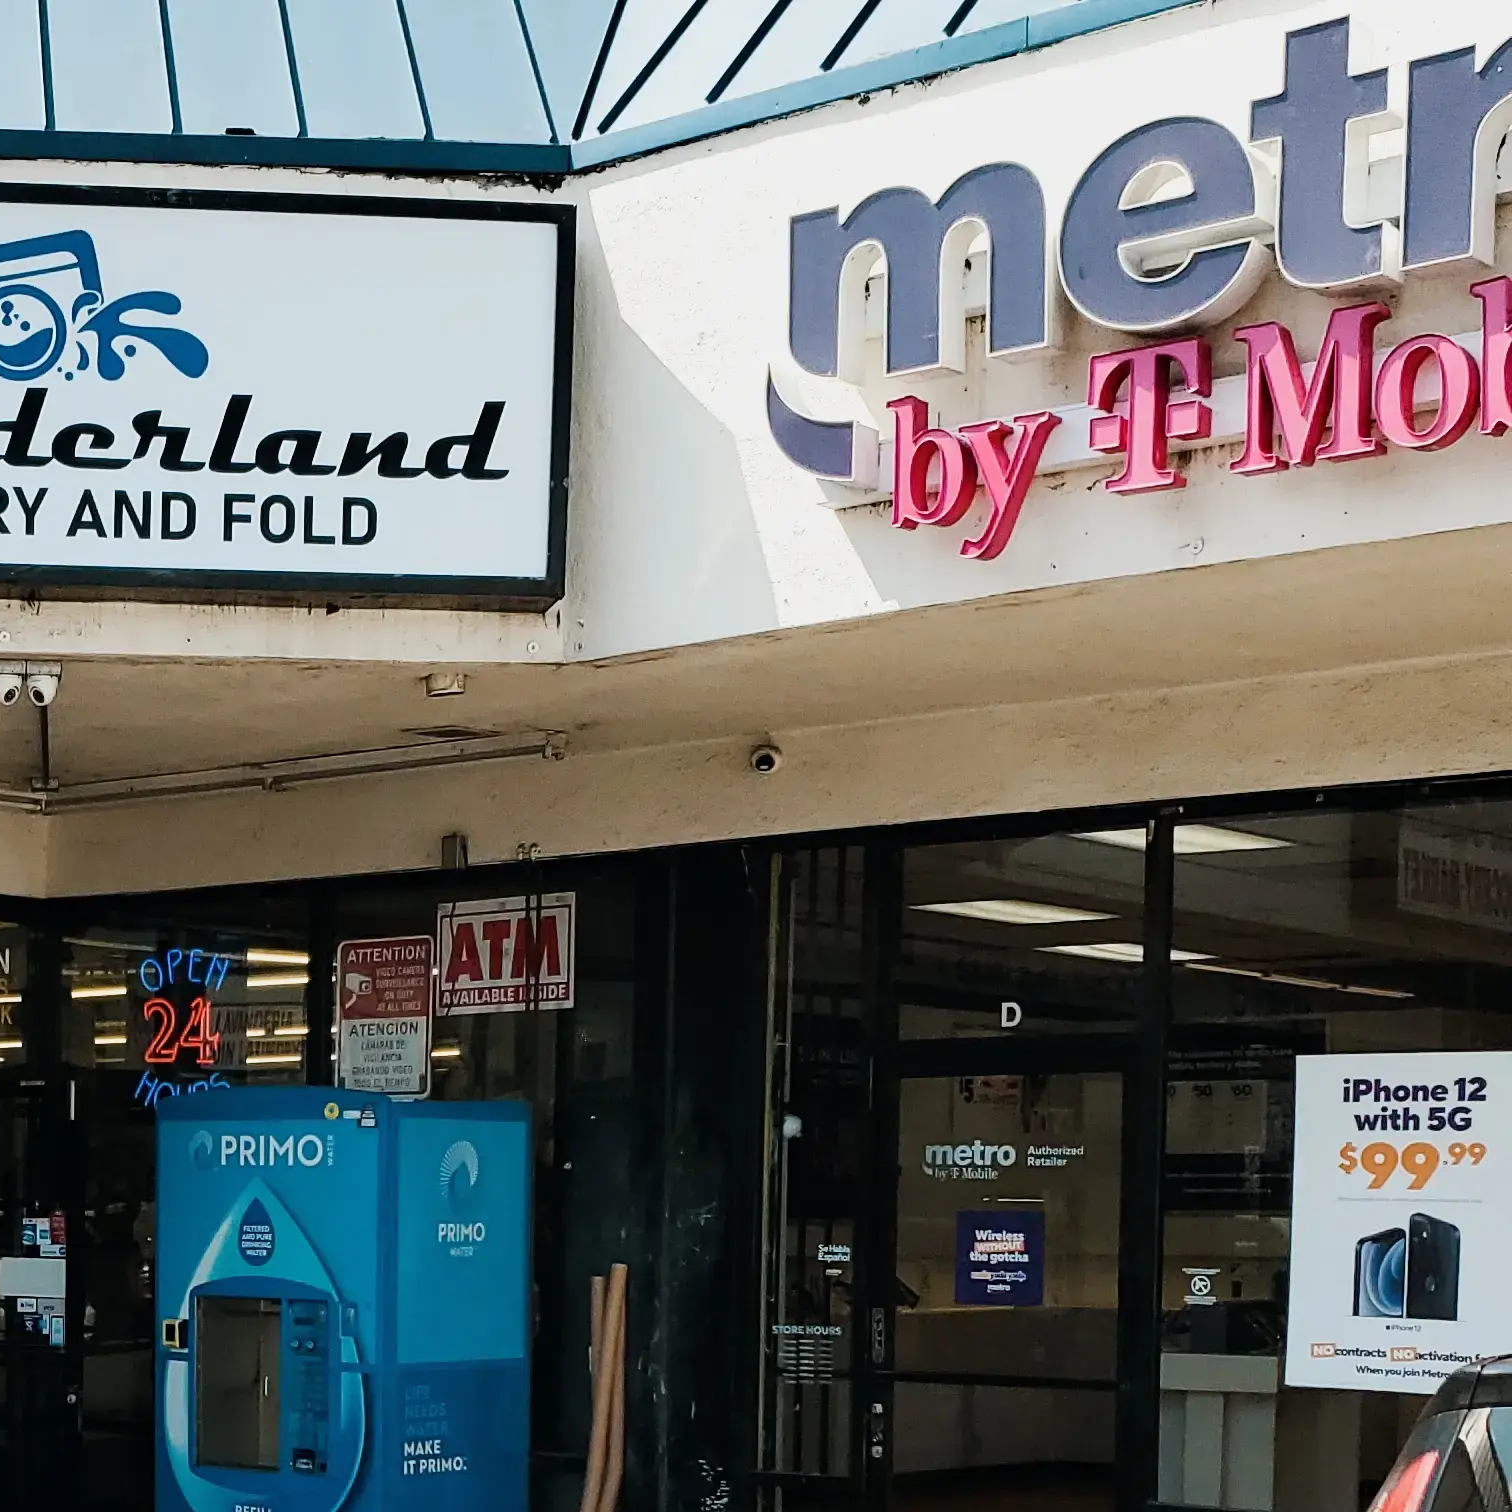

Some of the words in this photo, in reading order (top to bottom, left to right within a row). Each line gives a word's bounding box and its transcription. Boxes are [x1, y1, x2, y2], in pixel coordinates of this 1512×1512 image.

[887, 395, 1061, 560] by
[65, 487, 199, 543] AND
[222, 494, 380, 547] FOLD
[347, 946, 426, 964] ATTENTION
[444, 915, 561, 984] ATM
[140, 948, 231, 992] OPEN
[375, 967, 396, 978] VIDEO
[442, 988, 515, 1005] AVAILABLE
[1000, 1003, 1022, 1028] D
[143, 997, 220, 1064] 24
[349, 1022, 419, 1037] ATENCION
[1342, 1079, 1448, 1102] iPhone
[1453, 1077, 1487, 1101] 12
[1354, 1106, 1420, 1131] with
[1427, 1107, 1472, 1132] 5G
[221, 1134, 324, 1167] PRIMO
[925, 1139, 1016, 1167] metro
[1027, 1145, 1084, 1156] Authorized
[1027, 1156, 1067, 1167] Retailer
[438, 1222, 486, 1243] PRIMO
[975, 1229, 1024, 1241] Wireless
[975, 1241, 1022, 1252] WITHOUT
[969, 1251, 988, 1261] the
[990, 1251, 1029, 1264] gotcha
[772, 1325, 804, 1335] STORE
[806, 1325, 842, 1336] HOURS
[1313, 1344, 1335, 1356] NO
[1335, 1347, 1387, 1358] contracts
[1392, 1349, 1416, 1360] NO
[1356, 1366, 1383, 1375] When
[1384, 1367, 1401, 1377] you
[1402, 1367, 1420, 1378] join
[404, 1440, 441, 1457] MAKE
[404, 1459, 417, 1475] IT
